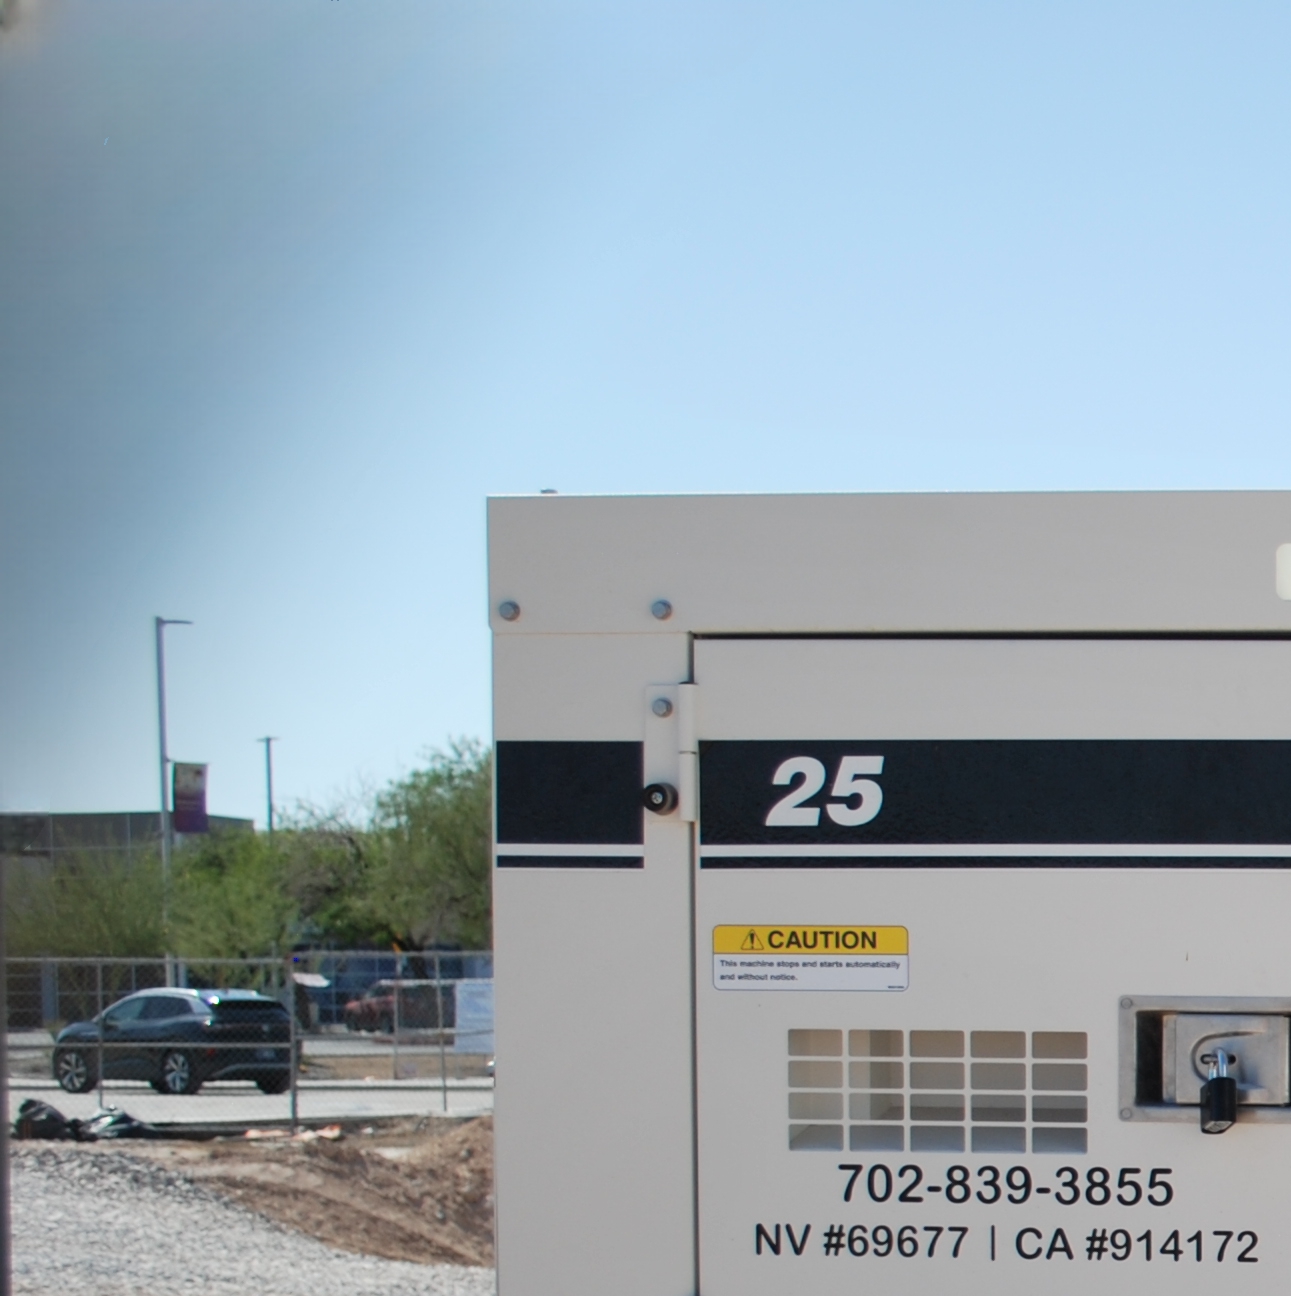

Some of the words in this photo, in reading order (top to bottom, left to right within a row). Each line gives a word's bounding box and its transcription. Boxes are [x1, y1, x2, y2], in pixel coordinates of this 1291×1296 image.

[764, 754, 885, 827] 25
[768, 930, 877, 949] CAUTION
[777, 961, 800, 969] stops
[846, 961, 900, 970] automatically
[837, 1163, 1175, 1206] 702-839-3855
[754, 1222, 811, 1257] NV
[823, 1224, 969, 1260] #69677
[1014, 1227, 1073, 1262] CA
[1085, 1229, 1259, 1263] #914172
